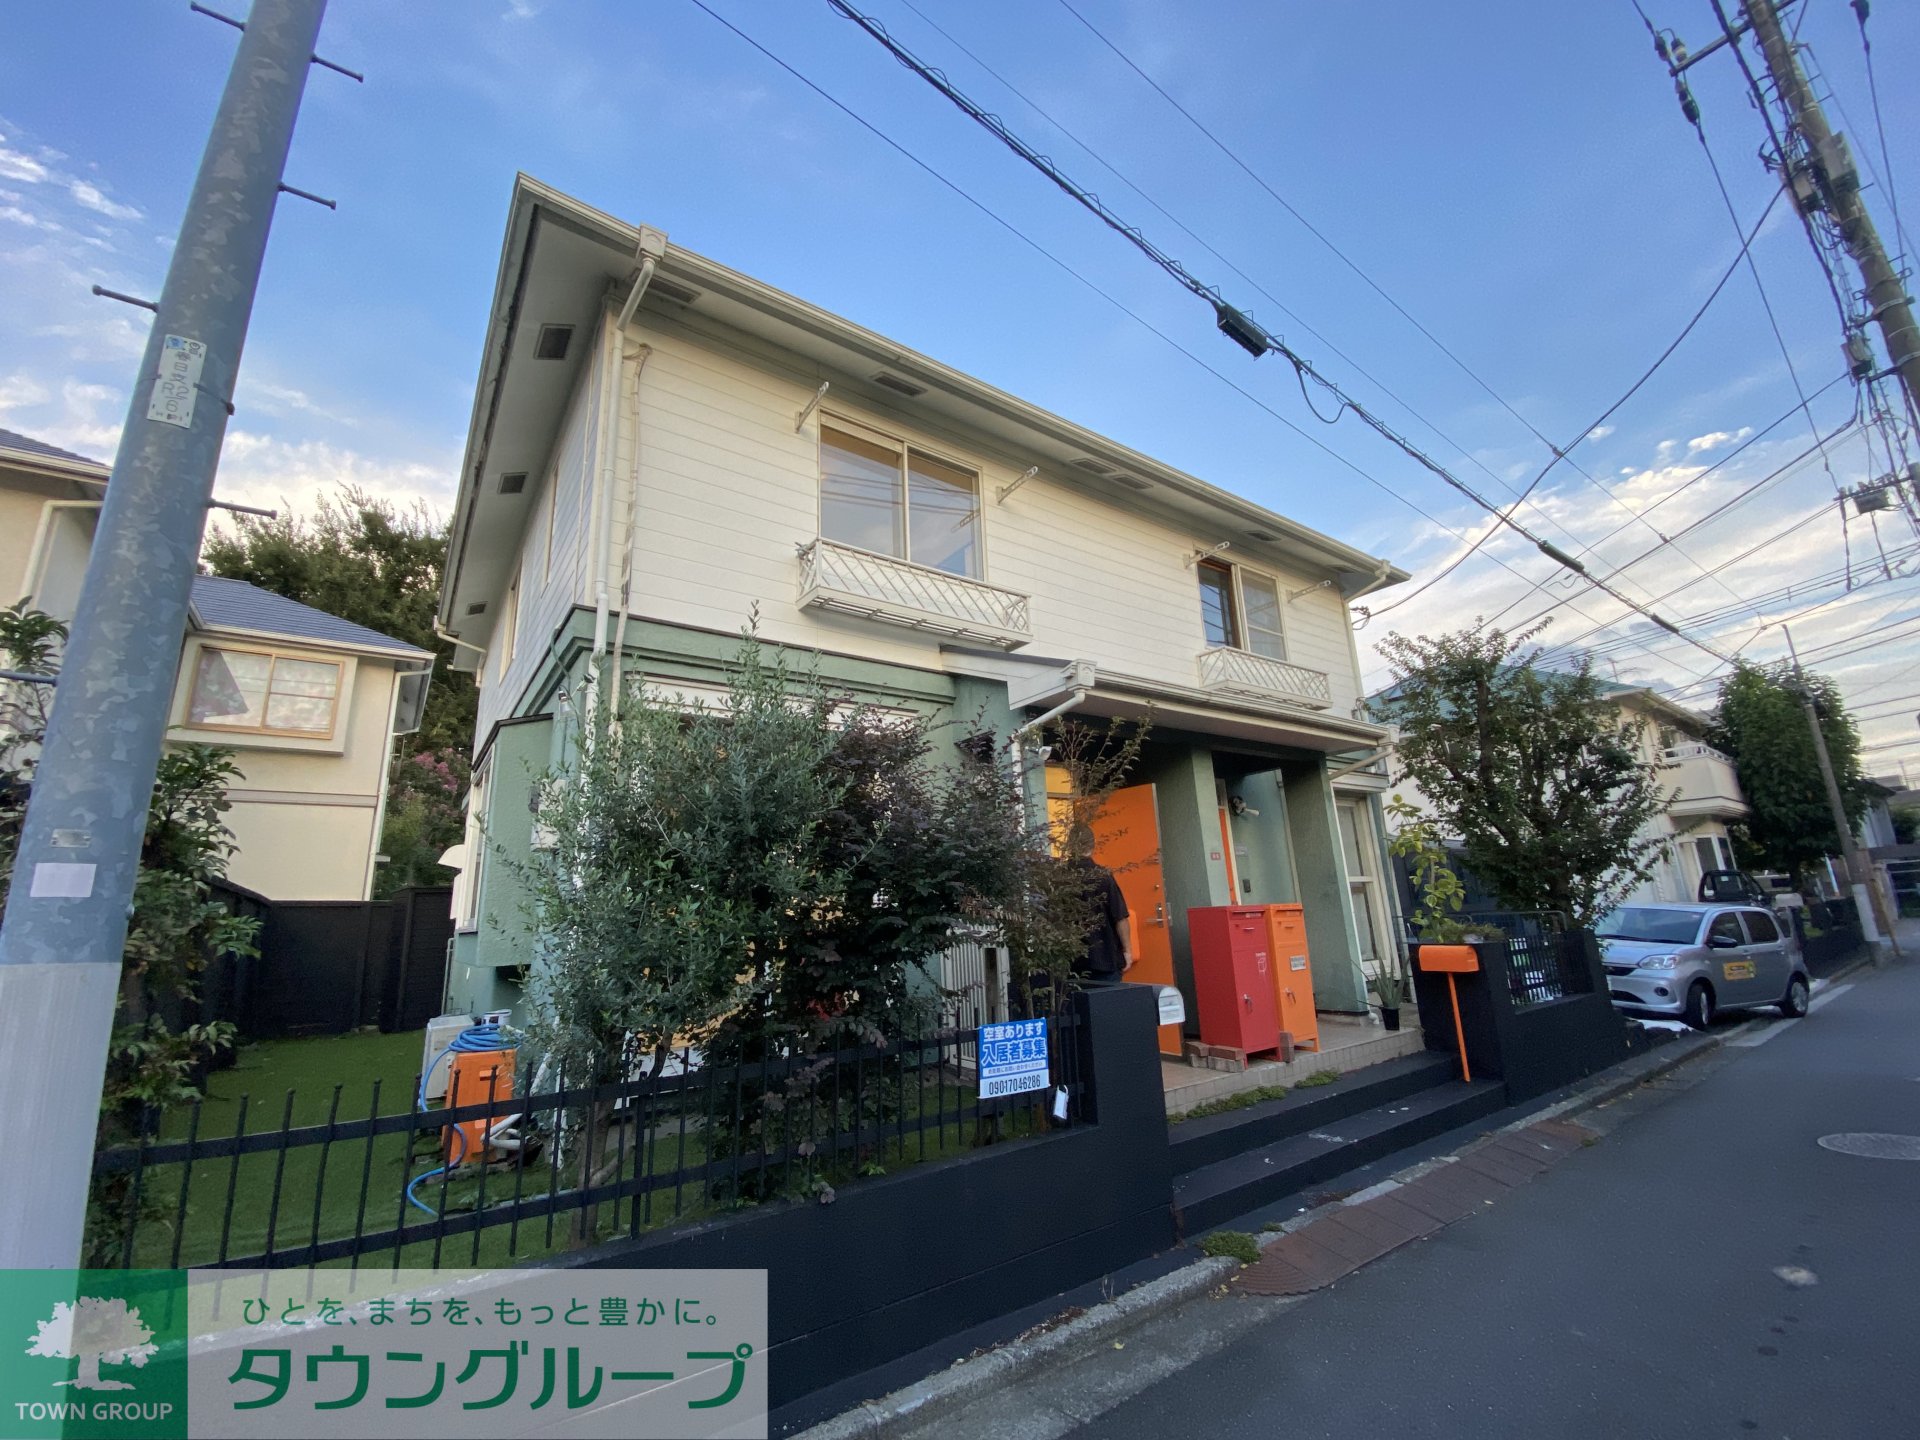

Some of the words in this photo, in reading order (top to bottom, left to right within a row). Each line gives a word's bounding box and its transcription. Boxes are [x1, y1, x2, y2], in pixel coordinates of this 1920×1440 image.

[983, 1021, 1044, 1042] 空室あります
[981, 1037, 1047, 1067] 入居者募集
[988, 1074, 1041, 1095] 09017046286
